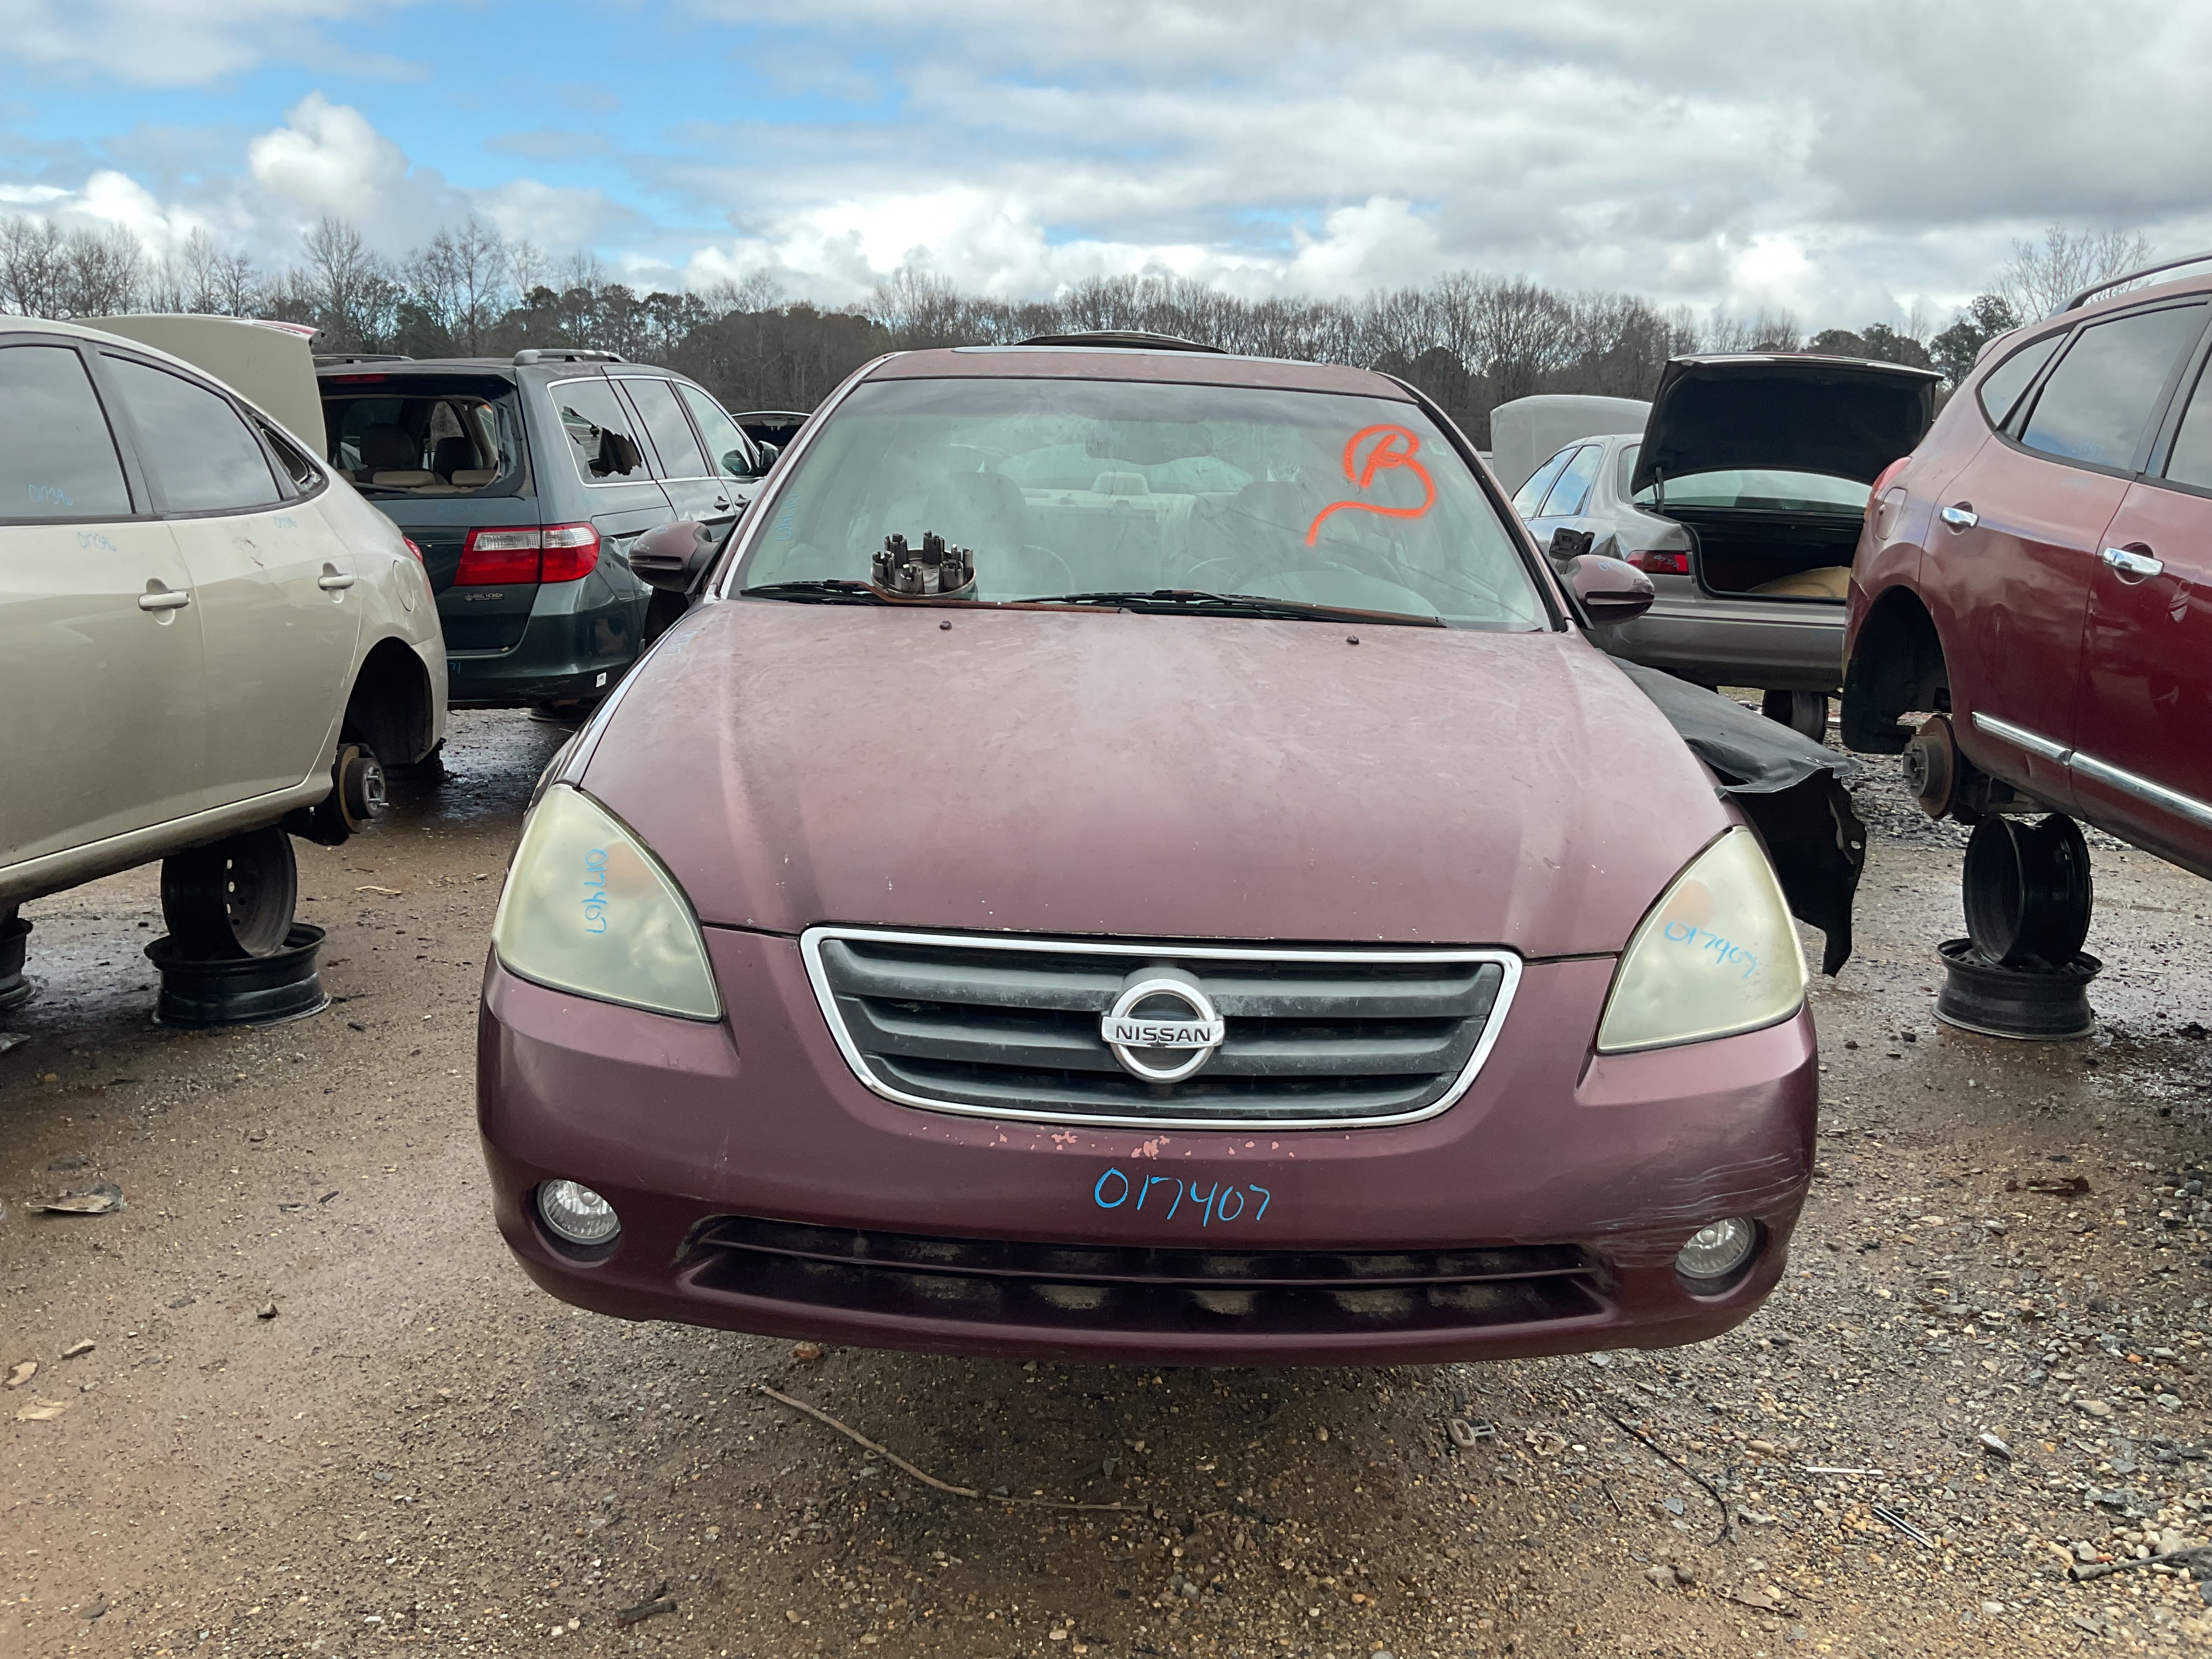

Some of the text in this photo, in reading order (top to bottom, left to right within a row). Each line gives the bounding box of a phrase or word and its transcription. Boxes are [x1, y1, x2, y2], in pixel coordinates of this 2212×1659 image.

[580, 849, 608, 934] 017407
[1664, 921, 1757, 979] 017407
[1116, 1024, 1210, 1042] NISSAN
[1094, 1167, 1271, 1227] 017407
